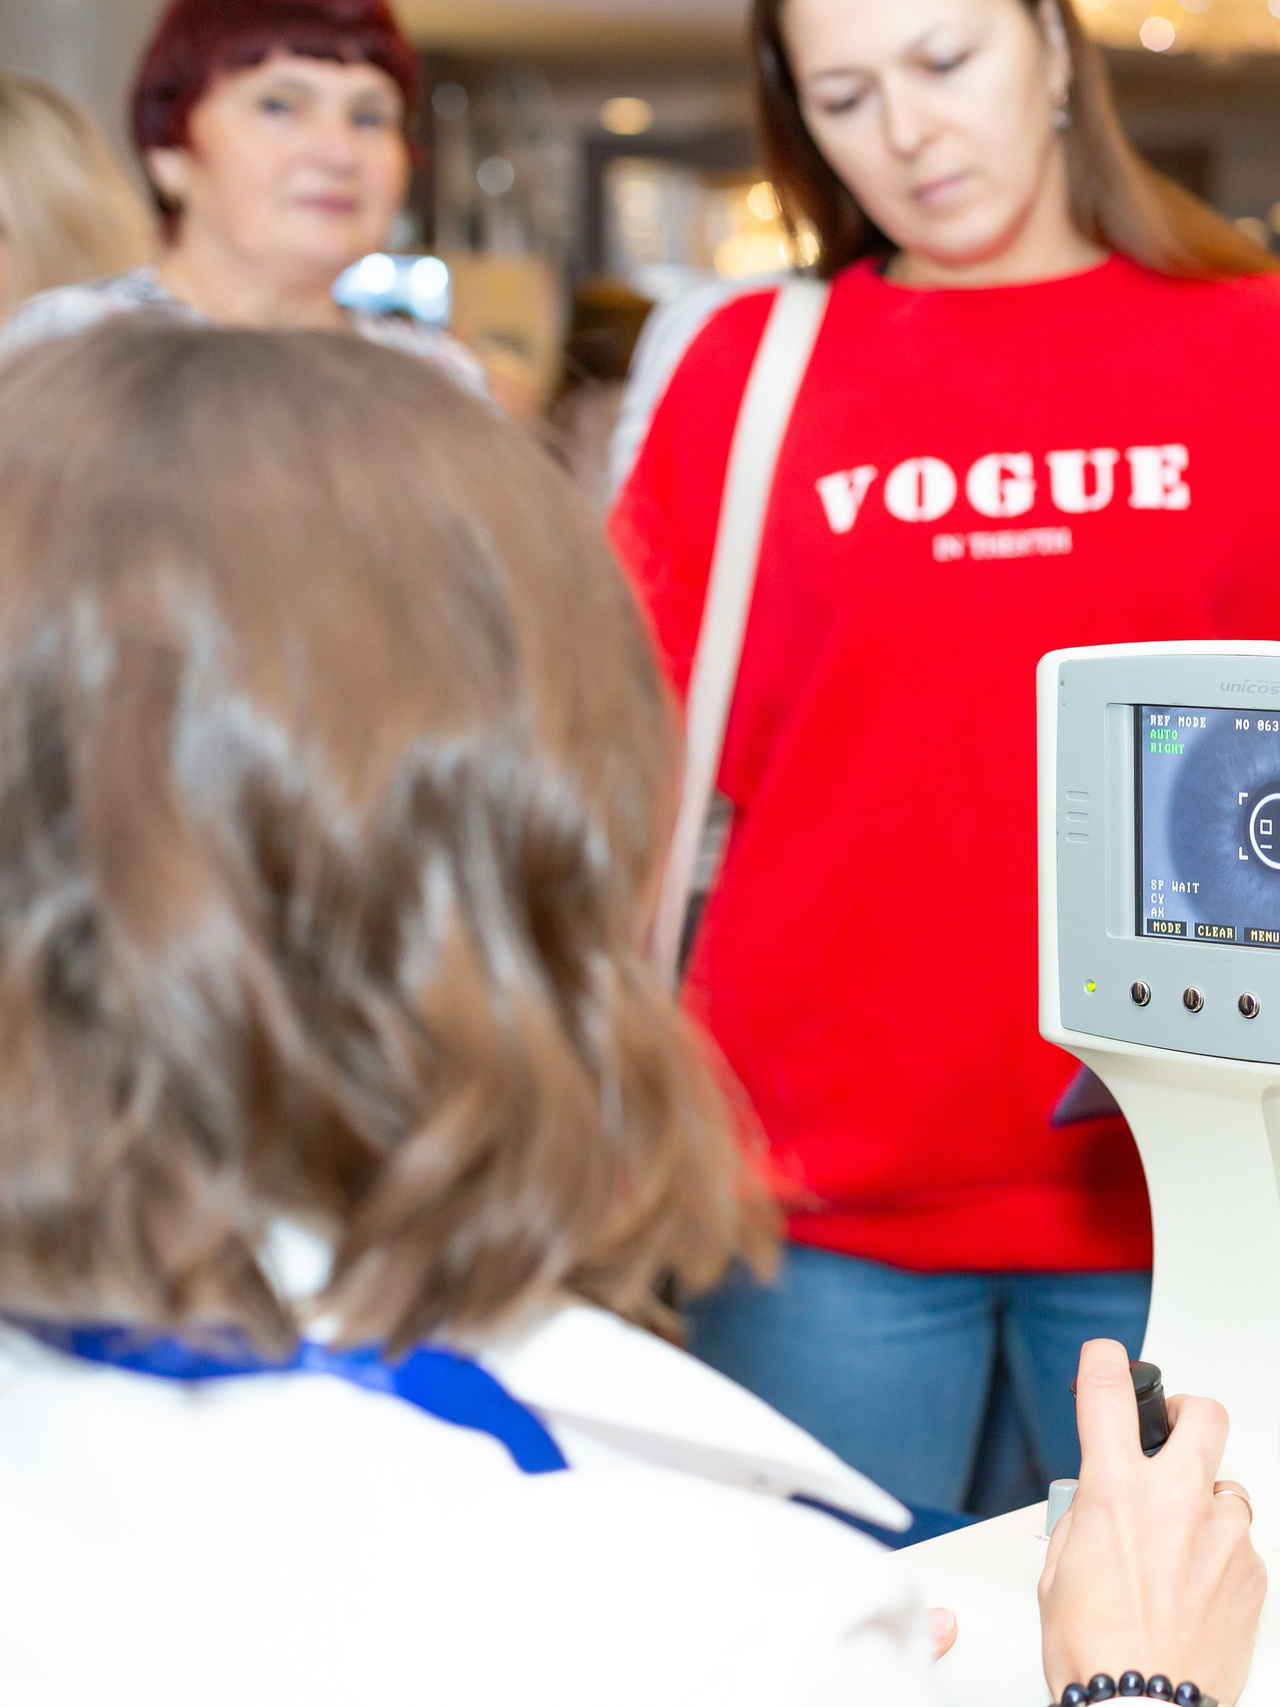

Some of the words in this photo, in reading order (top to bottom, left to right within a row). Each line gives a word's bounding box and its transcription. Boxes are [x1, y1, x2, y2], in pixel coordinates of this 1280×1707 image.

[815, 444, 1191, 534] VOGUE
[1220, 679, 1280, 695] unicos
[1150, 714, 1171, 728] REF
[1178, 715, 1207, 729] MODE
[1235, 718, 1250, 731] NO
[1150, 728, 1178, 741] AUTO
[1150, 742, 1185, 755] RIGHT
[1150, 880, 1164, 891] SP
[1171, 881, 1200, 894] WAIT
[1150, 893, 1165, 905] CY
[1150, 906, 1165, 918] AX
[1153, 921, 1182, 934] MODE
[1197, 925, 1233, 939] CLEAR
[1250, 929, 1280, 943] MENU
